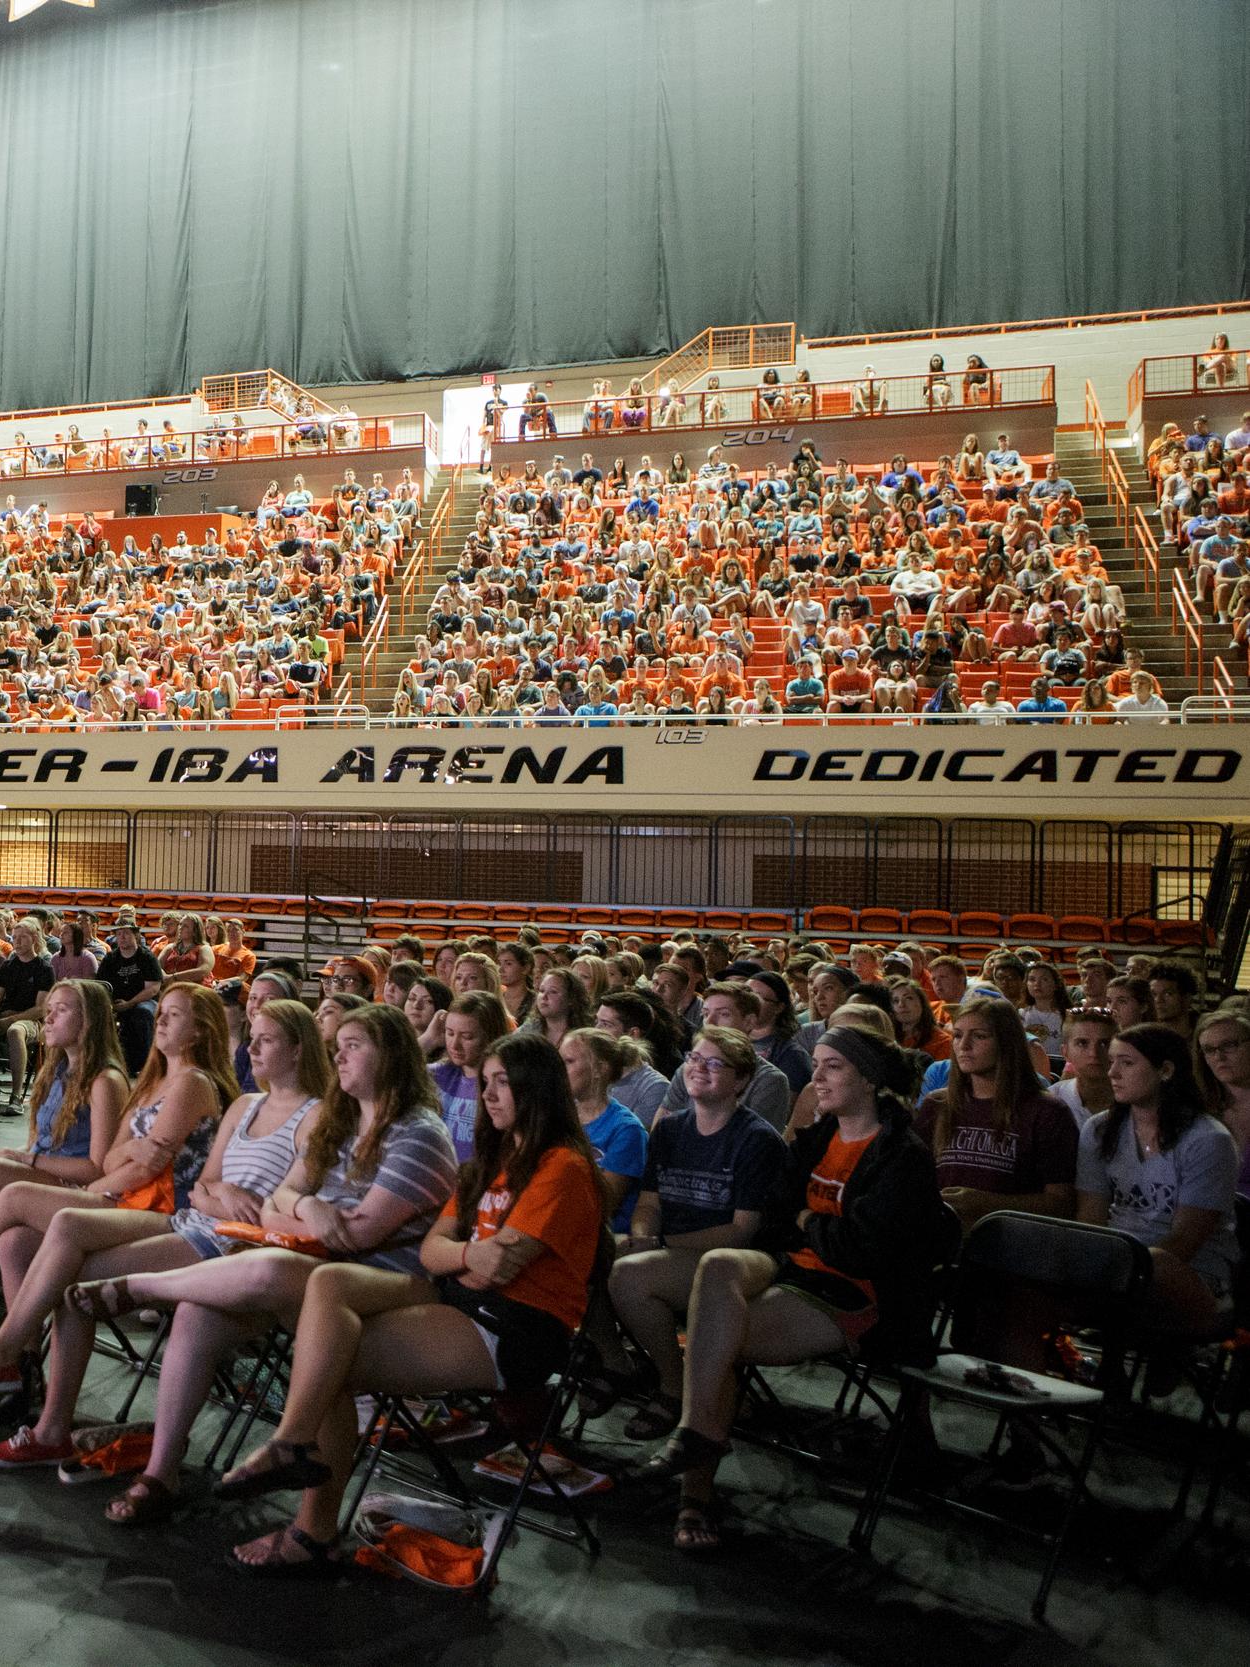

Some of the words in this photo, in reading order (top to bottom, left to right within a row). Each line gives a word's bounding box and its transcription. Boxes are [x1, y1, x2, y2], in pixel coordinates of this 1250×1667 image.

[722, 428, 793, 446] 204
[162, 468, 218, 484] 203
[655, 729, 708, 744] 103
[319, 747, 624, 784] ARENA
[752, 749, 1243, 783] DEDICATED
